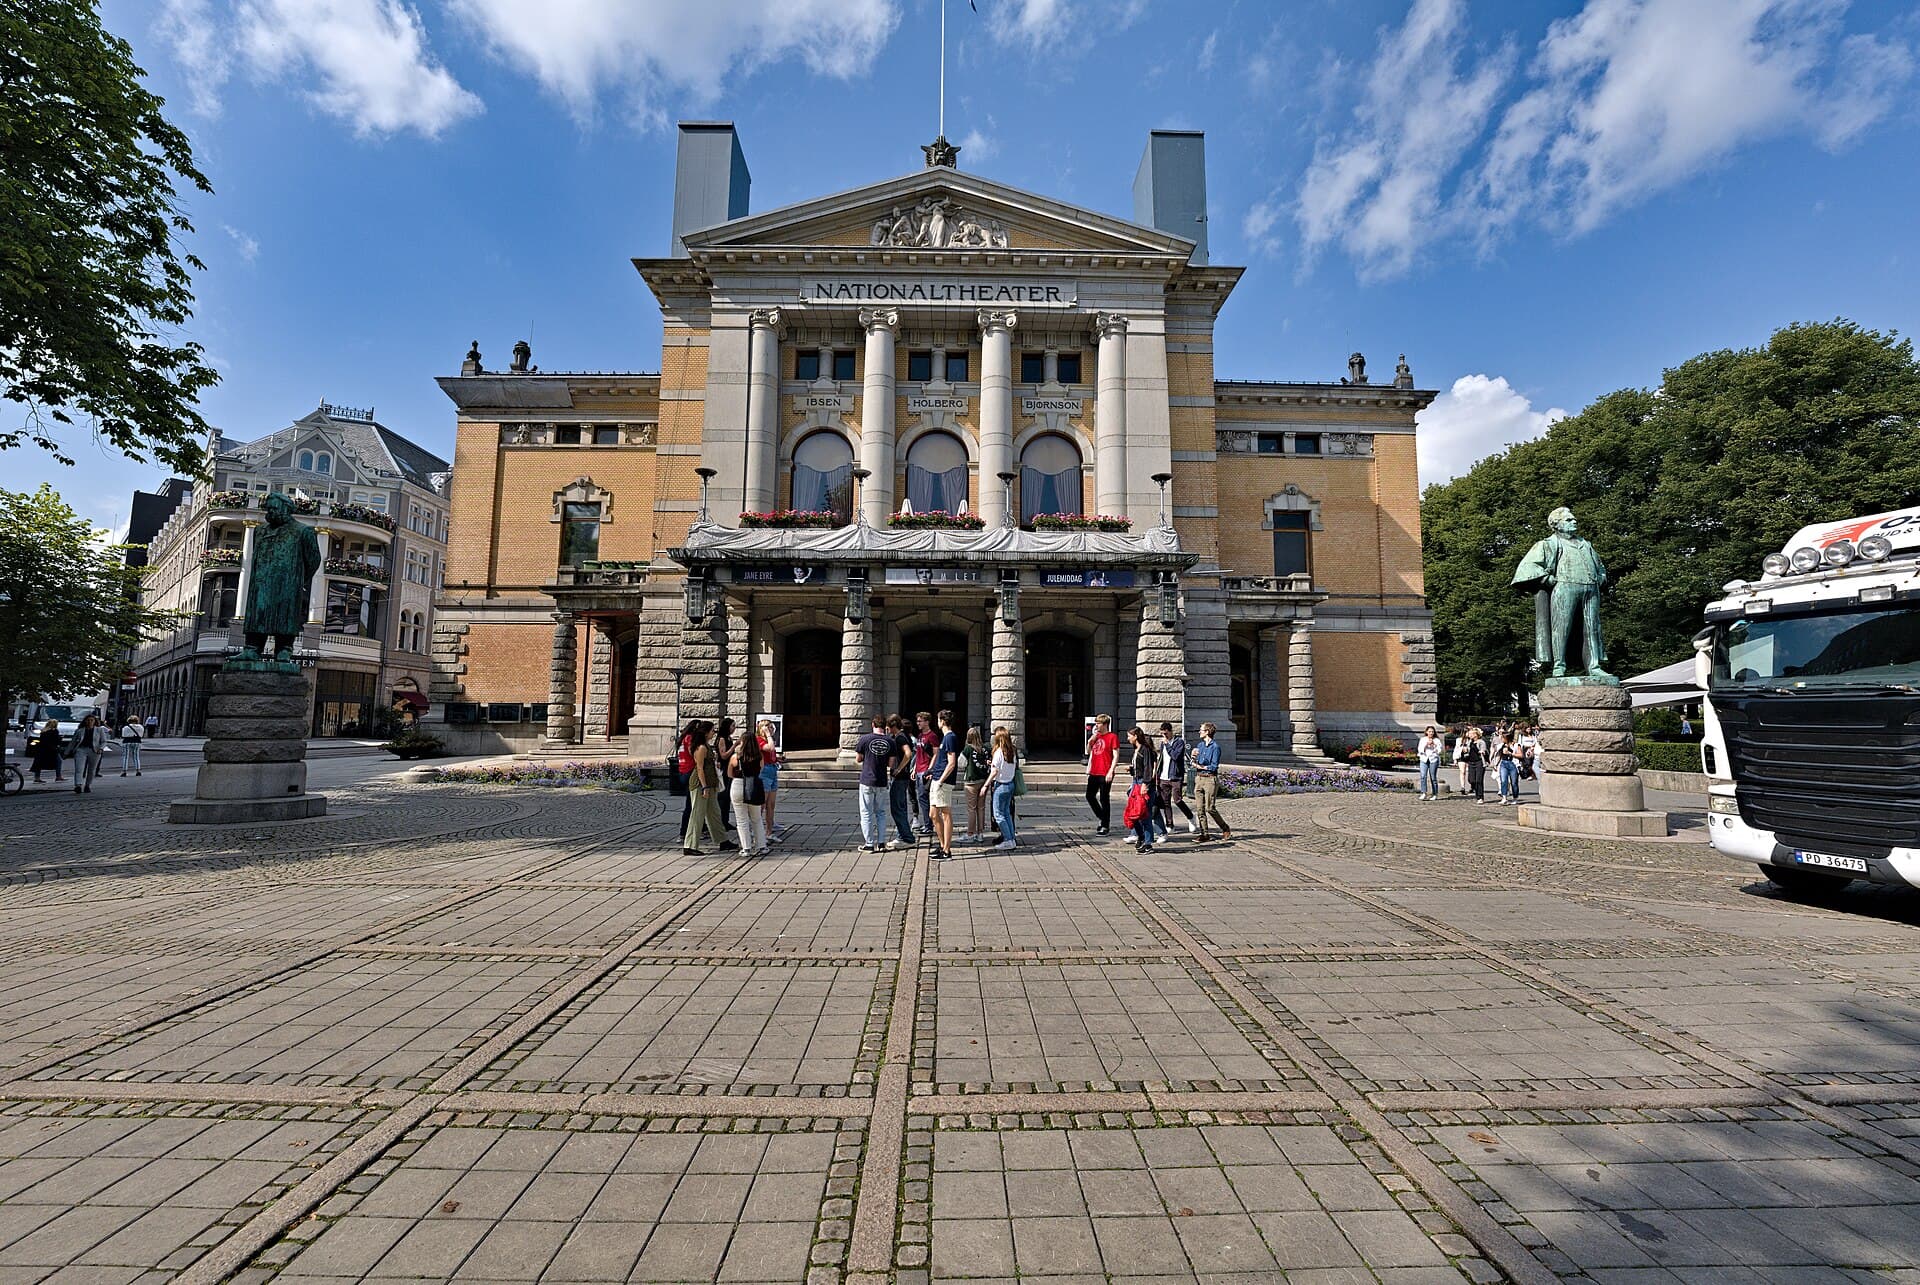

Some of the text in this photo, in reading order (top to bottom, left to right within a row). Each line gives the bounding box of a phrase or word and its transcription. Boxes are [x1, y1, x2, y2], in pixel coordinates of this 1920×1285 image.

[816, 283, 1062, 302] NATIONALTHEATER
[806, 398, 841, 407] IBSEN
[913, 399, 964, 408] HOLBERG
[1025, 400, 1080, 410] BJØRNSON
[743, 571, 774, 580] JANE EYRE
[1047, 574, 1083, 583] JULEMIDDAG
[1806, 853, 1864, 870] PD 36475
